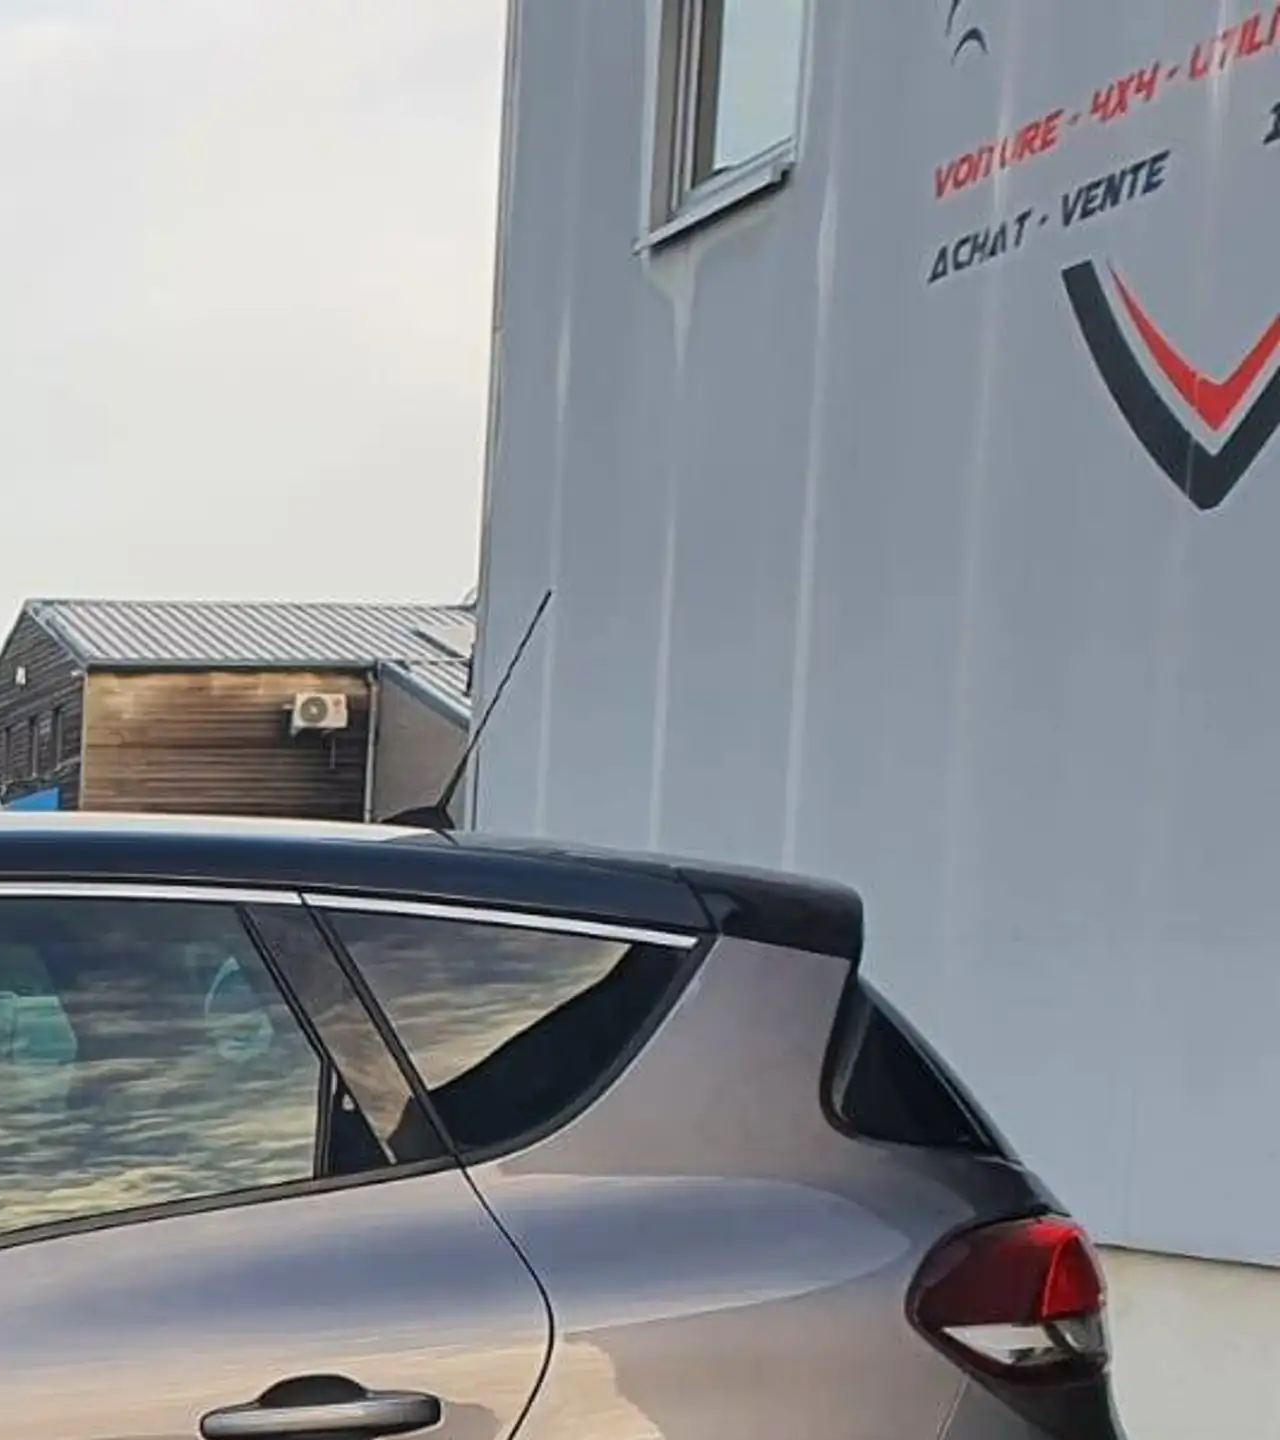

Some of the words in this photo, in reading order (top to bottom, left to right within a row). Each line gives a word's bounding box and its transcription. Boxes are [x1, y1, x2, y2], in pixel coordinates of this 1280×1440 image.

[935, 108, 1064, 198] VOITURE
[1091, 61, 1159, 121] 4X4
[928, 207, 1033, 283] ACHAT
[1061, 150, 1171, 227] VENTE
